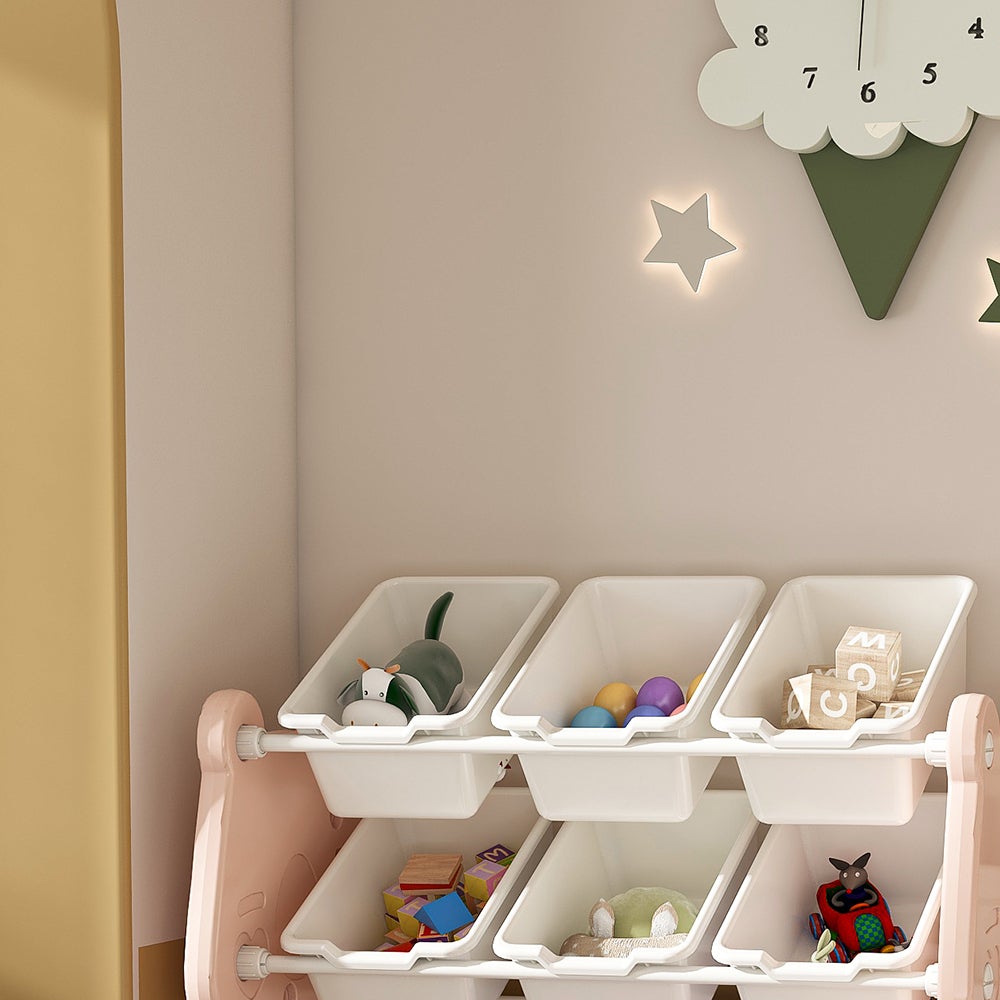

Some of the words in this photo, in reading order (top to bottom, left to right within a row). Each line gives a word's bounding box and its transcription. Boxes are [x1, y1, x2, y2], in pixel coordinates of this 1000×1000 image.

[754, 25, 769, 46] 8
[967, 17, 984, 39] 4
[802, 67, 818, 88] 7
[922, 62, 937, 84] 5
[860, 81, 876, 103] 6
